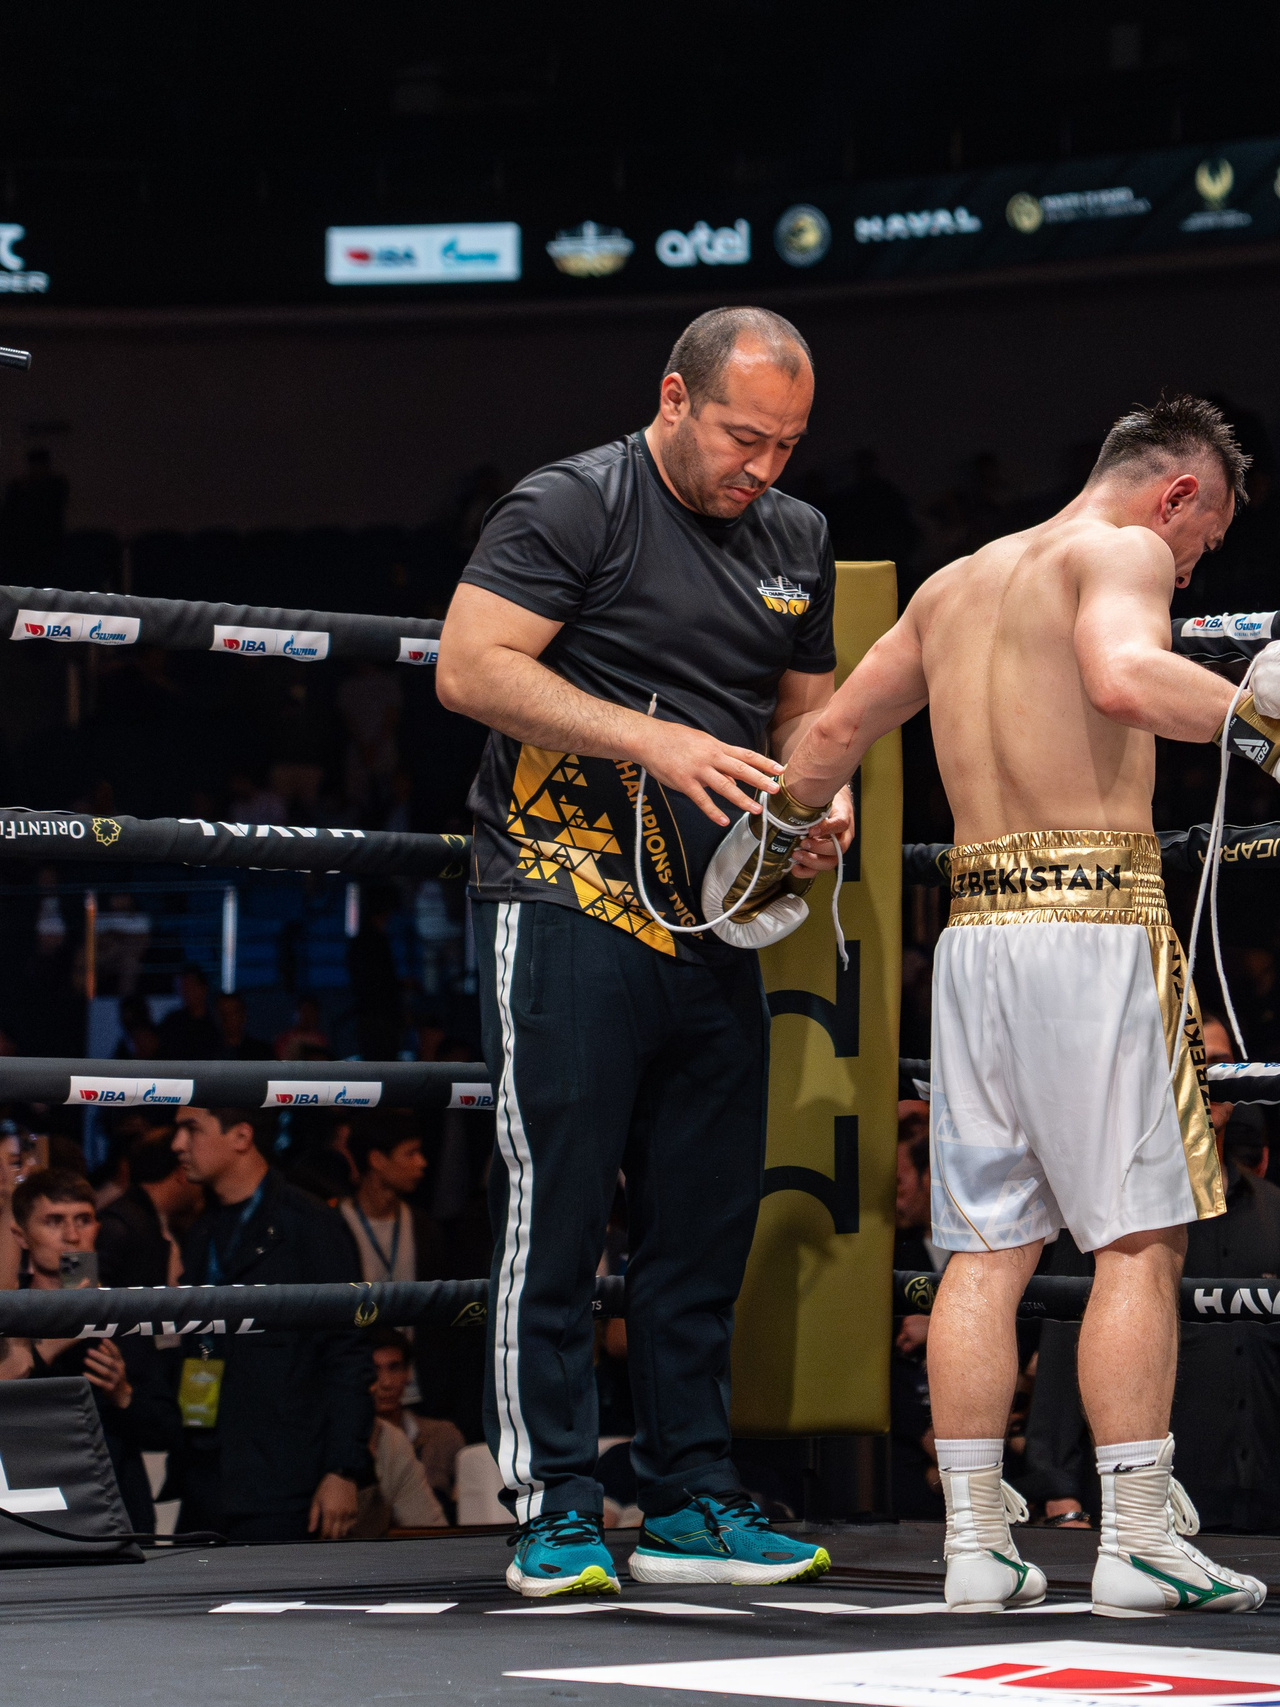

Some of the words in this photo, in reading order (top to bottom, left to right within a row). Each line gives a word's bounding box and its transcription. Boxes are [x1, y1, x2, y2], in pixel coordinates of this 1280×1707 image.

[46, 625, 71, 637] IBA
[240, 640, 266, 652] IBA
[423, 652, 438, 662] IB
[613, 757, 675, 885] HAMPIONS'
[99, 1091, 125, 1101] IBA
[293, 1094, 318, 1104] IBA
[74, 1318, 265, 1339] HAVAL
